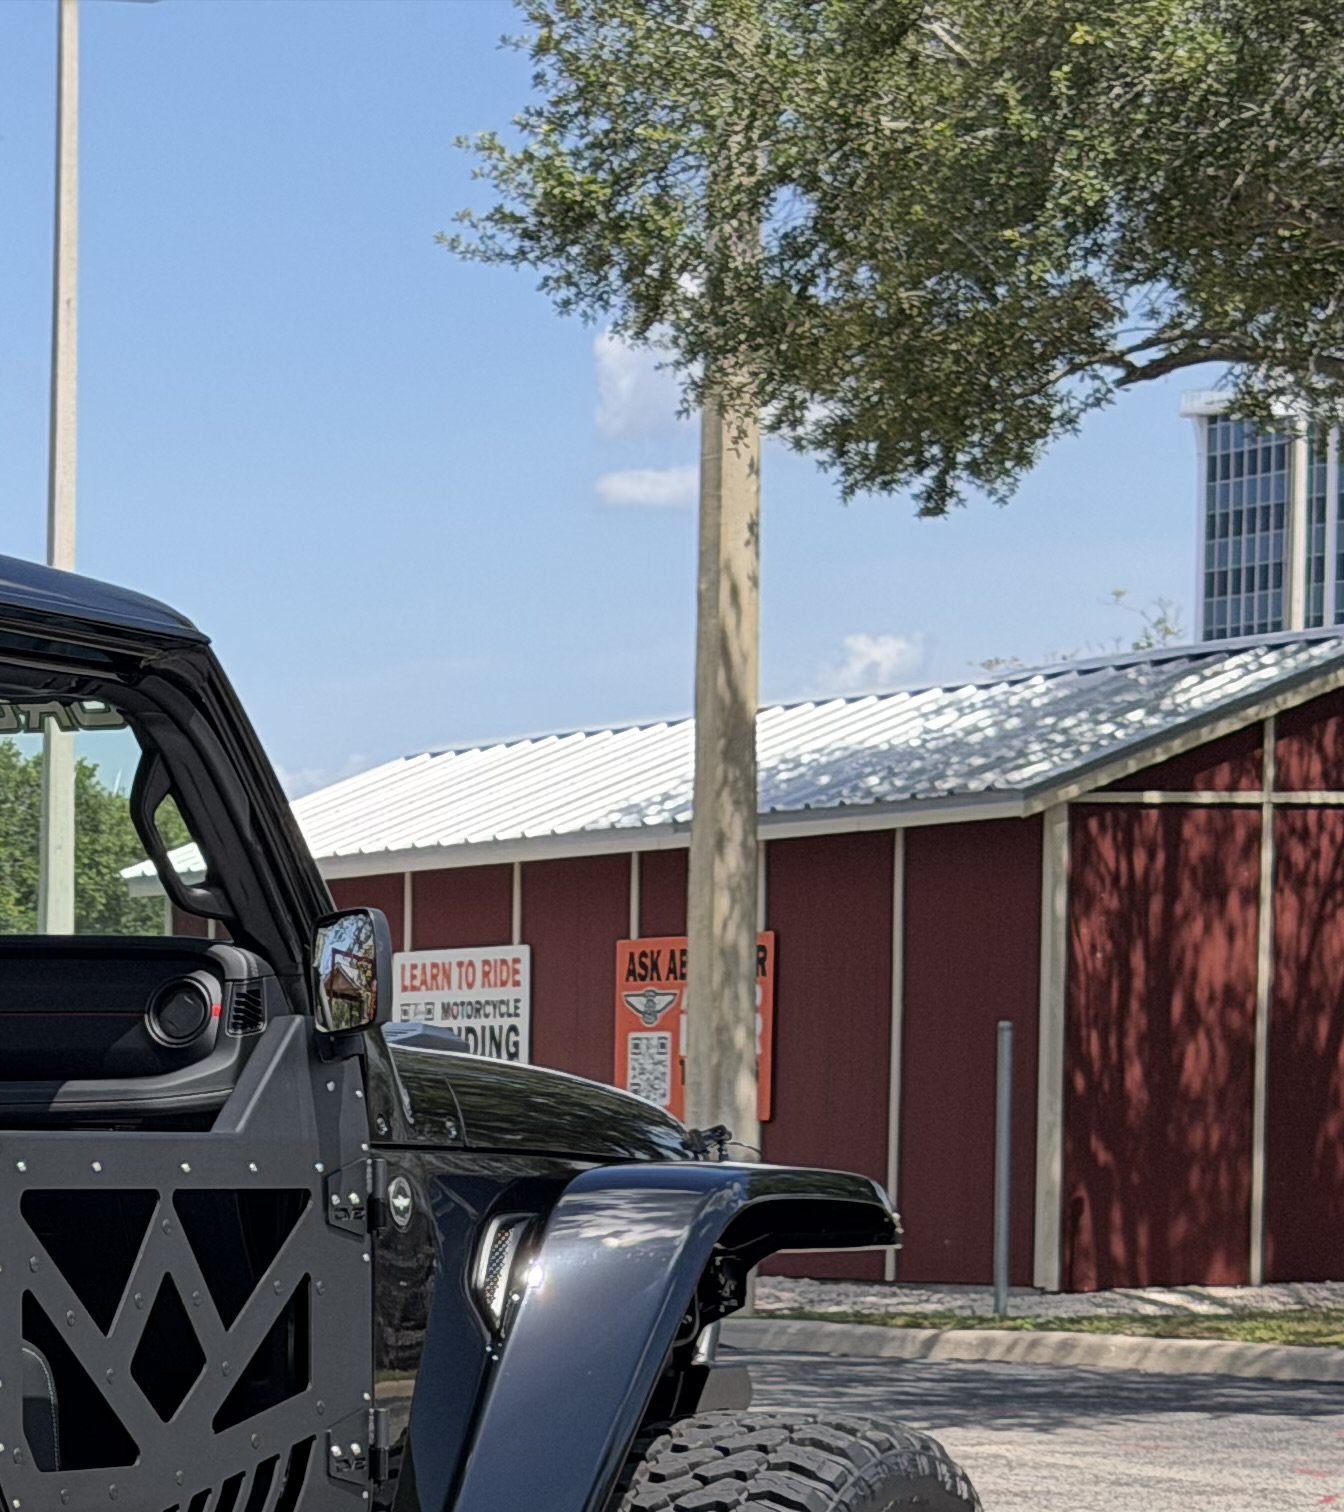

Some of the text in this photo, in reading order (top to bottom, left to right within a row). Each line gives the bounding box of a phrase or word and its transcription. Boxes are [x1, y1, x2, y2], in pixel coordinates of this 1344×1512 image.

[400, 957, 521, 992] LEARN TO RIDE
[625, 950, 662, 982] ASK
[440, 998, 521, 1021] MOTORCYCLE
